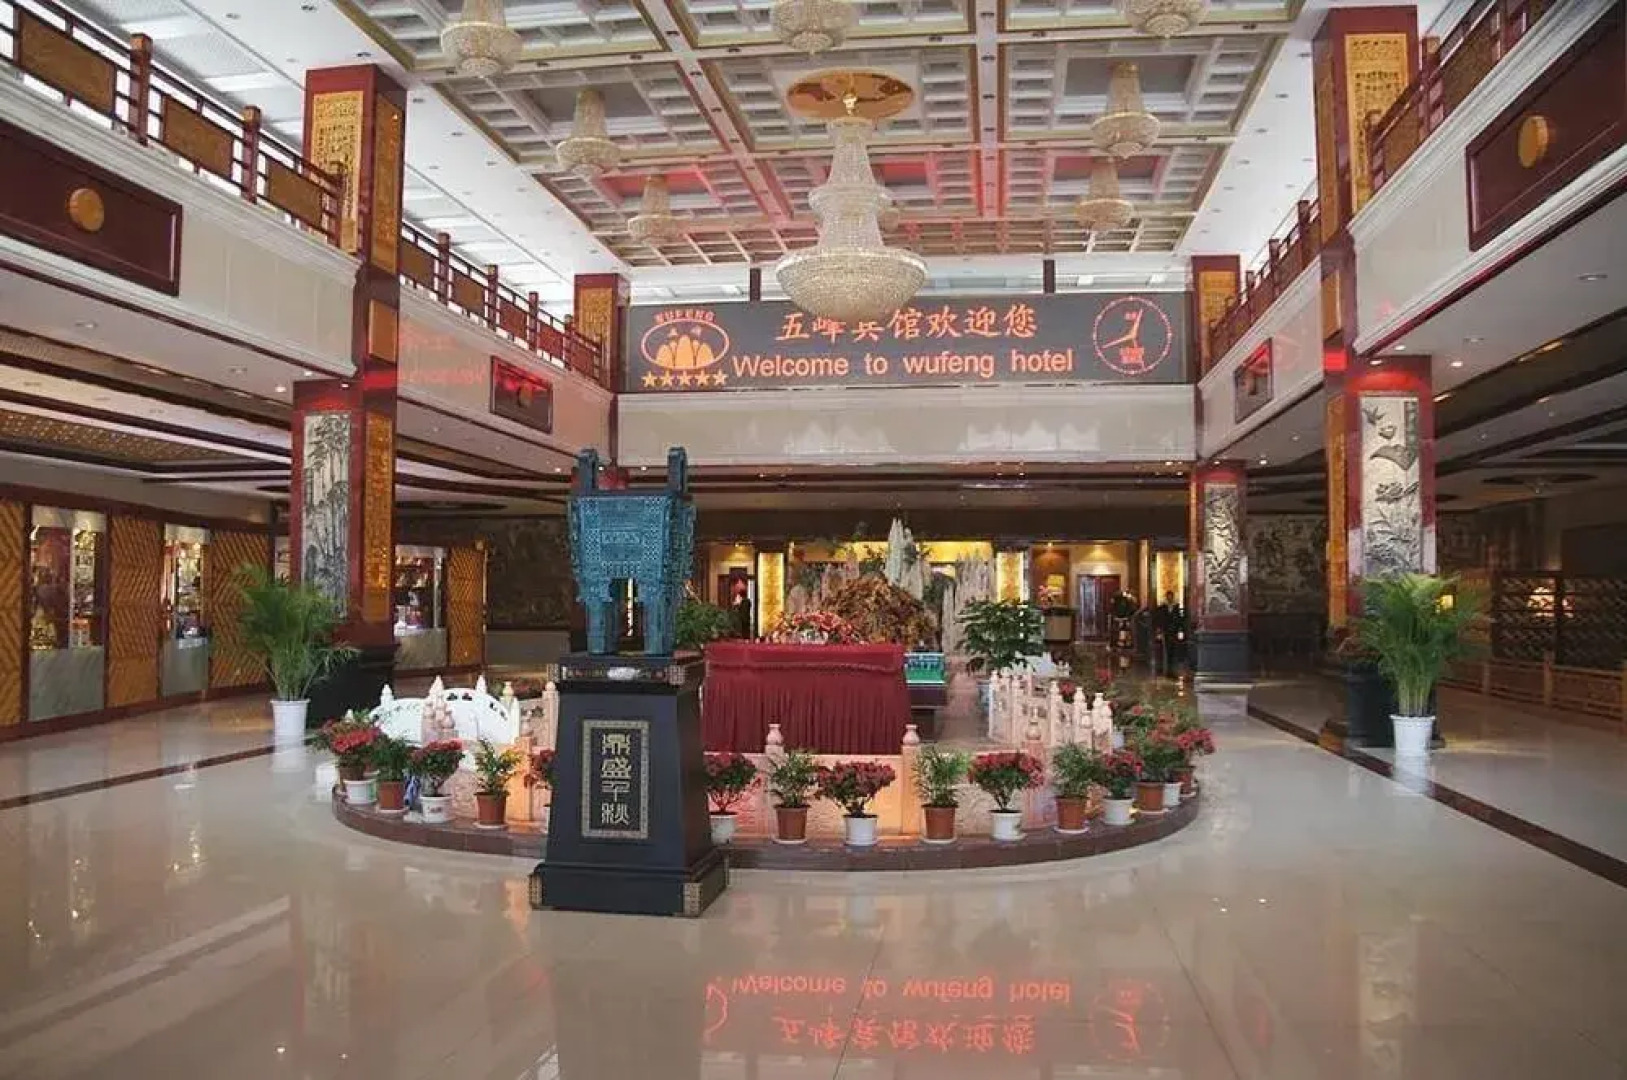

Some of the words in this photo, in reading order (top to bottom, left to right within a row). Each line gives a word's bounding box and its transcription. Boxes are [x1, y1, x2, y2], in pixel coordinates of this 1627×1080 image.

[732, 354, 849, 378] Welcome
[864, 352, 889, 376] to
[903, 351, 995, 378] wufeng
[1010, 349, 1073, 374] hotel
